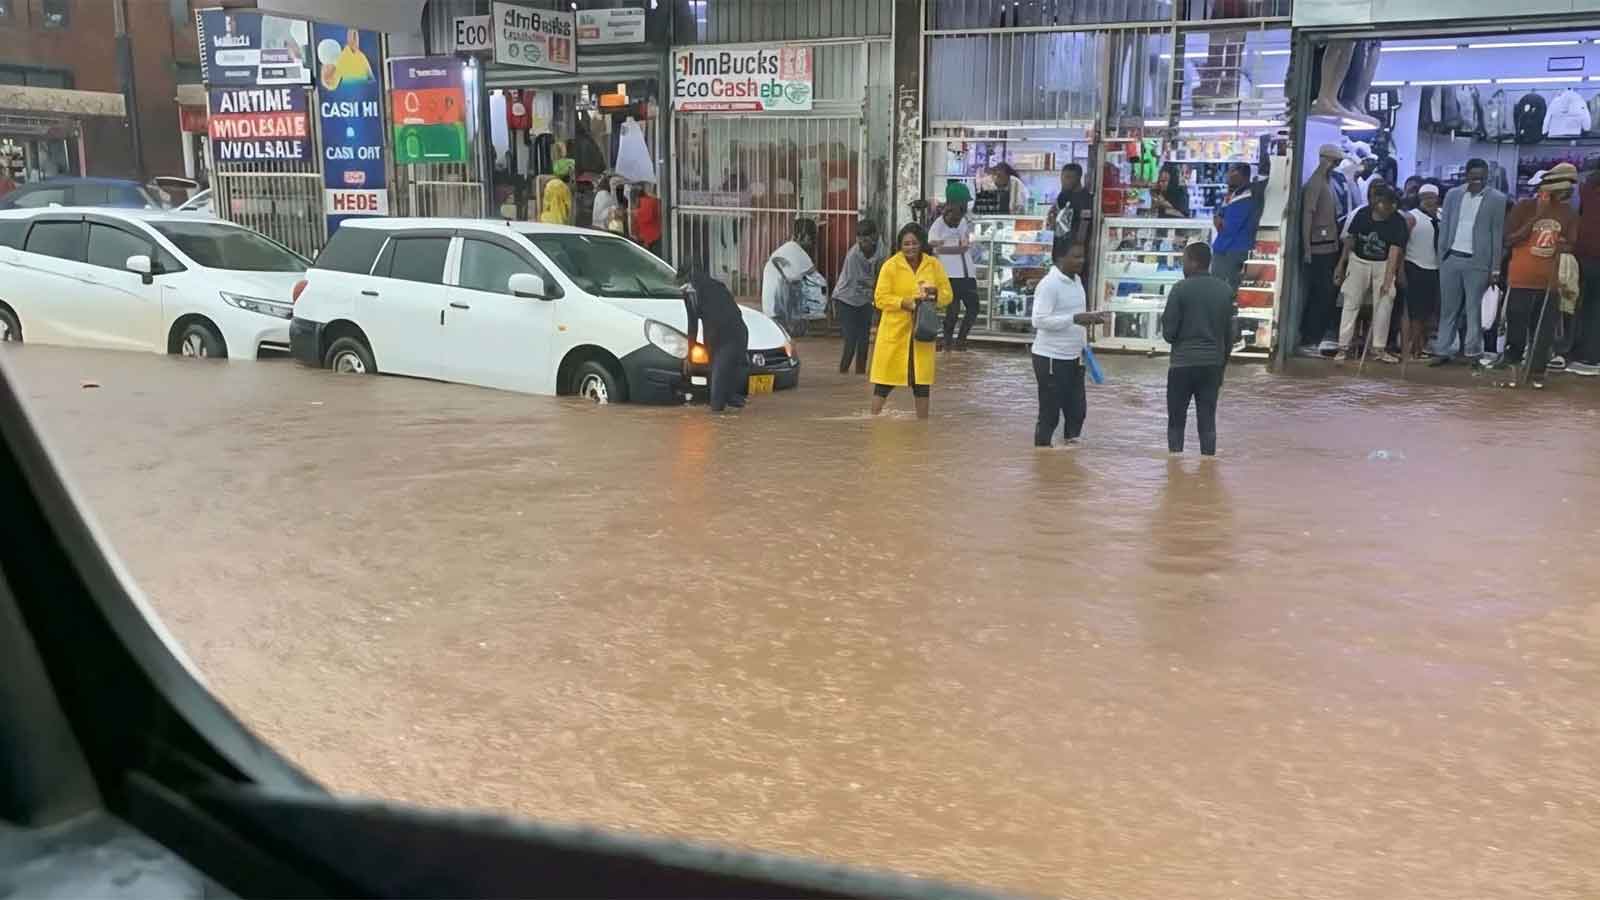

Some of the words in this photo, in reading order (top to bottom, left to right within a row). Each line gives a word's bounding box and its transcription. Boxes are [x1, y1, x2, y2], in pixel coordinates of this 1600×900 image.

[689, 50, 778, 75] InnBucks
[674, 79, 758, 97] EcoCash
[220, 89, 292, 113] AIRTIME
[333, 193, 378, 210] HEDE
